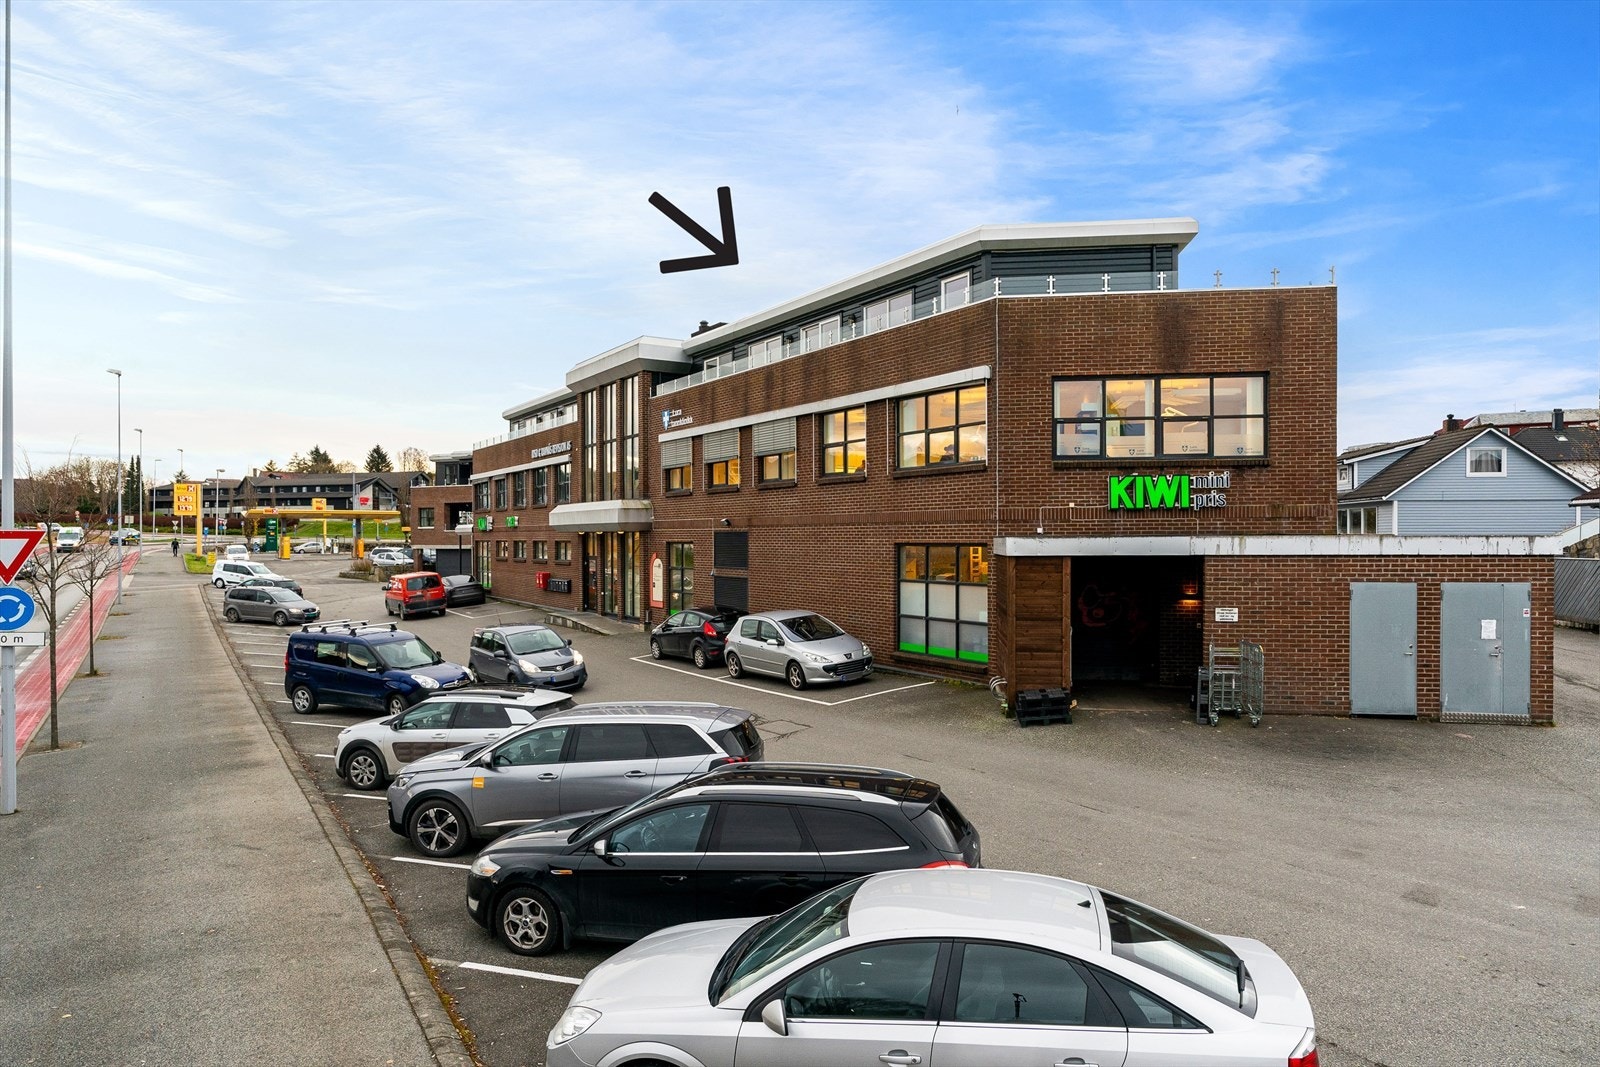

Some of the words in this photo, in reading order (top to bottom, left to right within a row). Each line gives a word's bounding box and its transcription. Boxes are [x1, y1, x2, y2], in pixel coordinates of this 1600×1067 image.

[1193, 471, 1230, 488] mini
[1108, 474, 1191, 509] KIWI
[1193, 490, 1226, 510] pris
